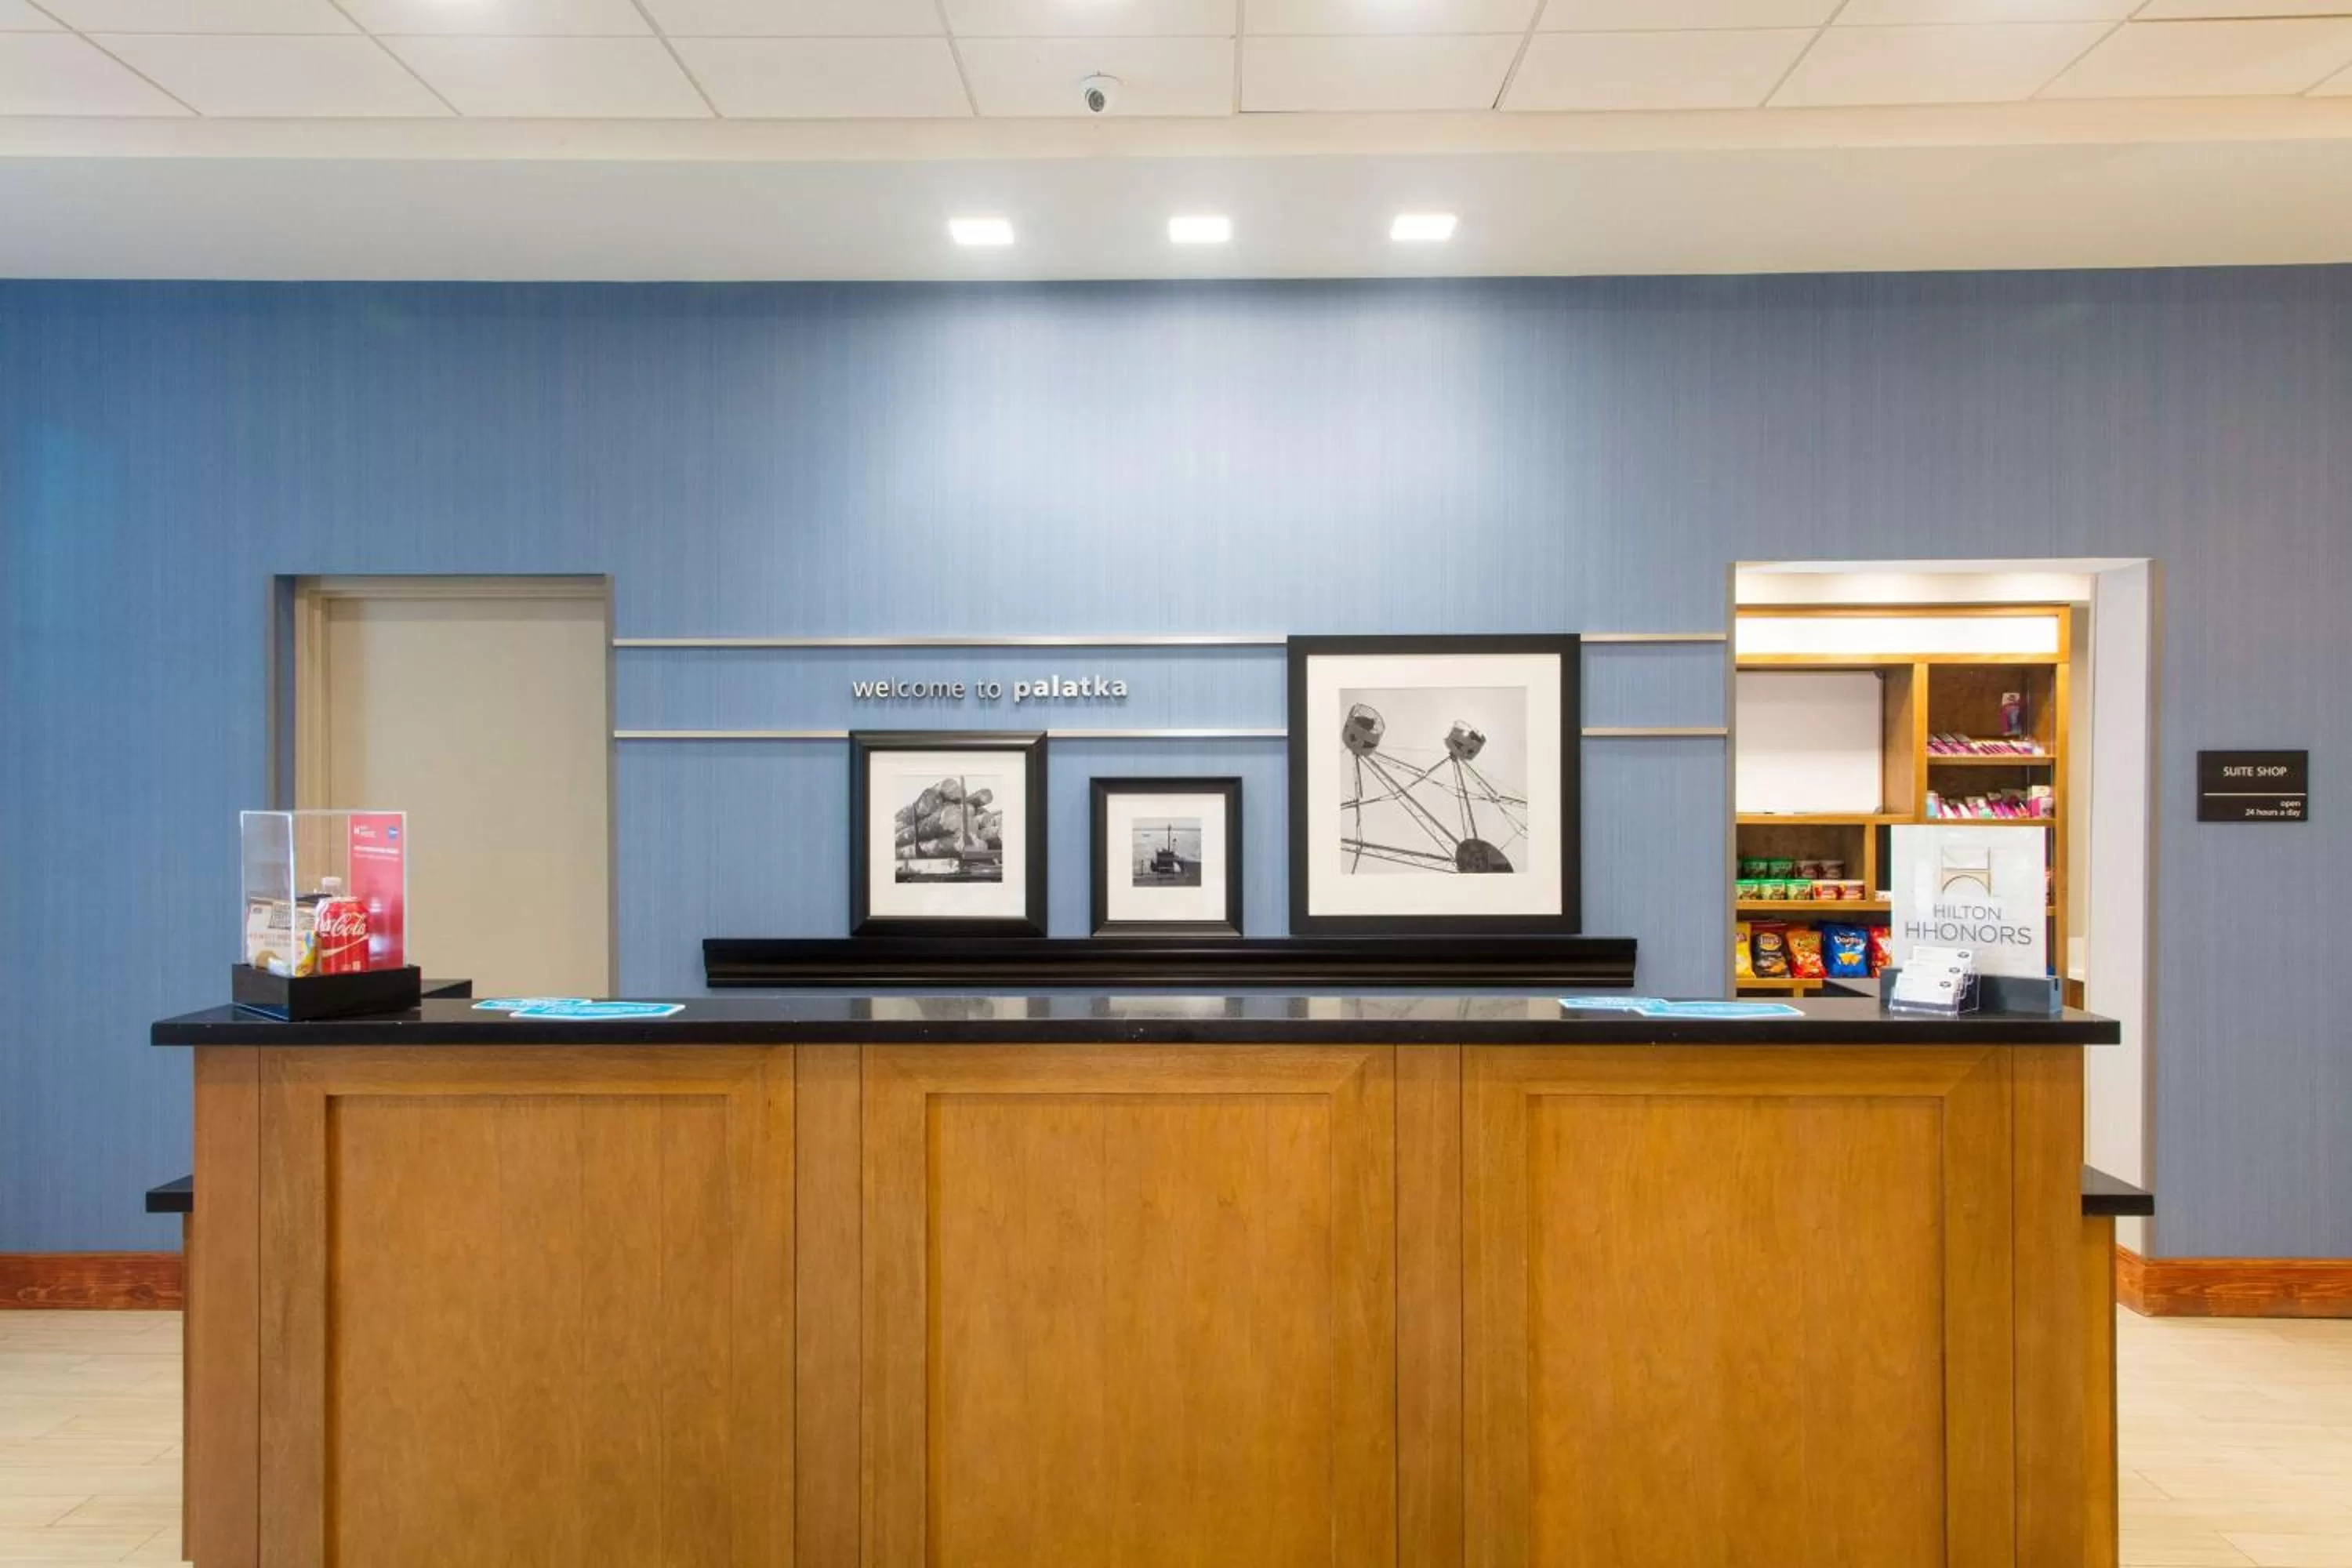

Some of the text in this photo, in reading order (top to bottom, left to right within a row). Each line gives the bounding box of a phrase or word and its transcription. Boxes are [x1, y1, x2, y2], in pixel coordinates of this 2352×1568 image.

[853, 675, 1128, 703] welcome to palatka
[2223, 766, 2288, 777] SUITE SHOP
[2286, 808, 2301, 817] day
[1933, 903, 2002, 920] HILTON
[1904, 920, 2032, 946] HHONORS
